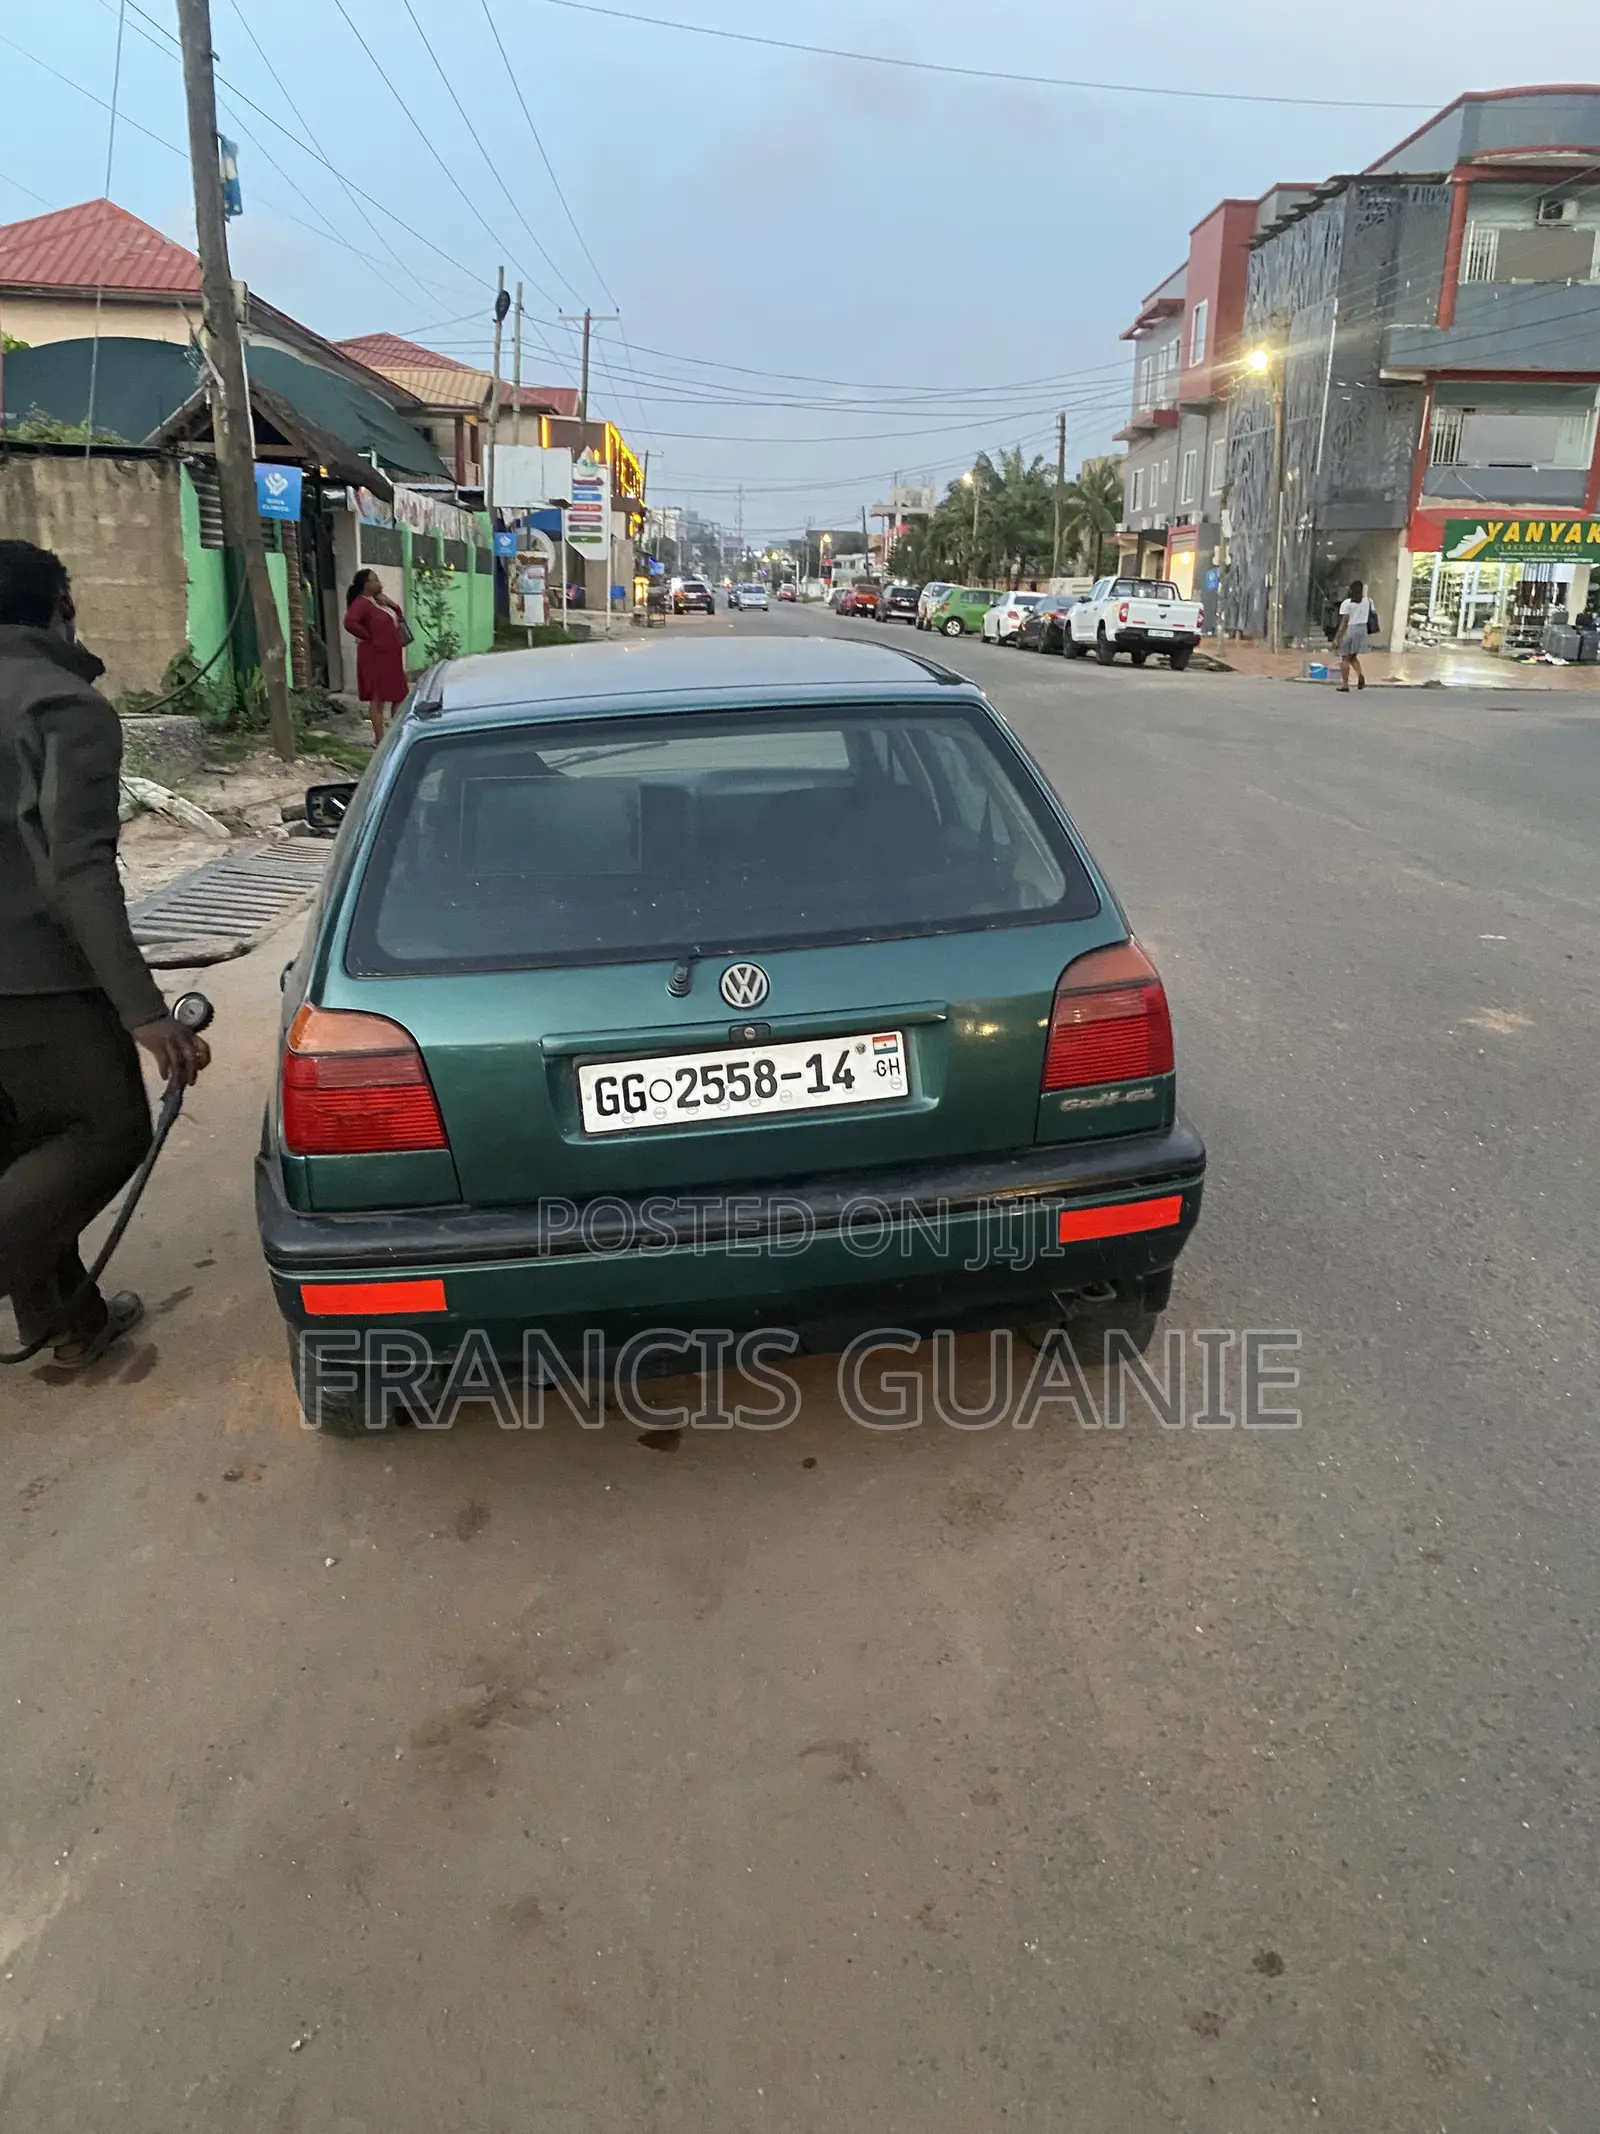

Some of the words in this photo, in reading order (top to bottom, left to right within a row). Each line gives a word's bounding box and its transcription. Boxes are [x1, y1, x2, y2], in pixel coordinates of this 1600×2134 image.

[1494, 543, 1533, 551] CLASSIC
[1536, 543, 1584, 552] VENTURES
[876, 1058, 900, 1077] GH
[594, 1073, 647, 1116] GG
[675, 1050, 855, 1109] 2558-14
